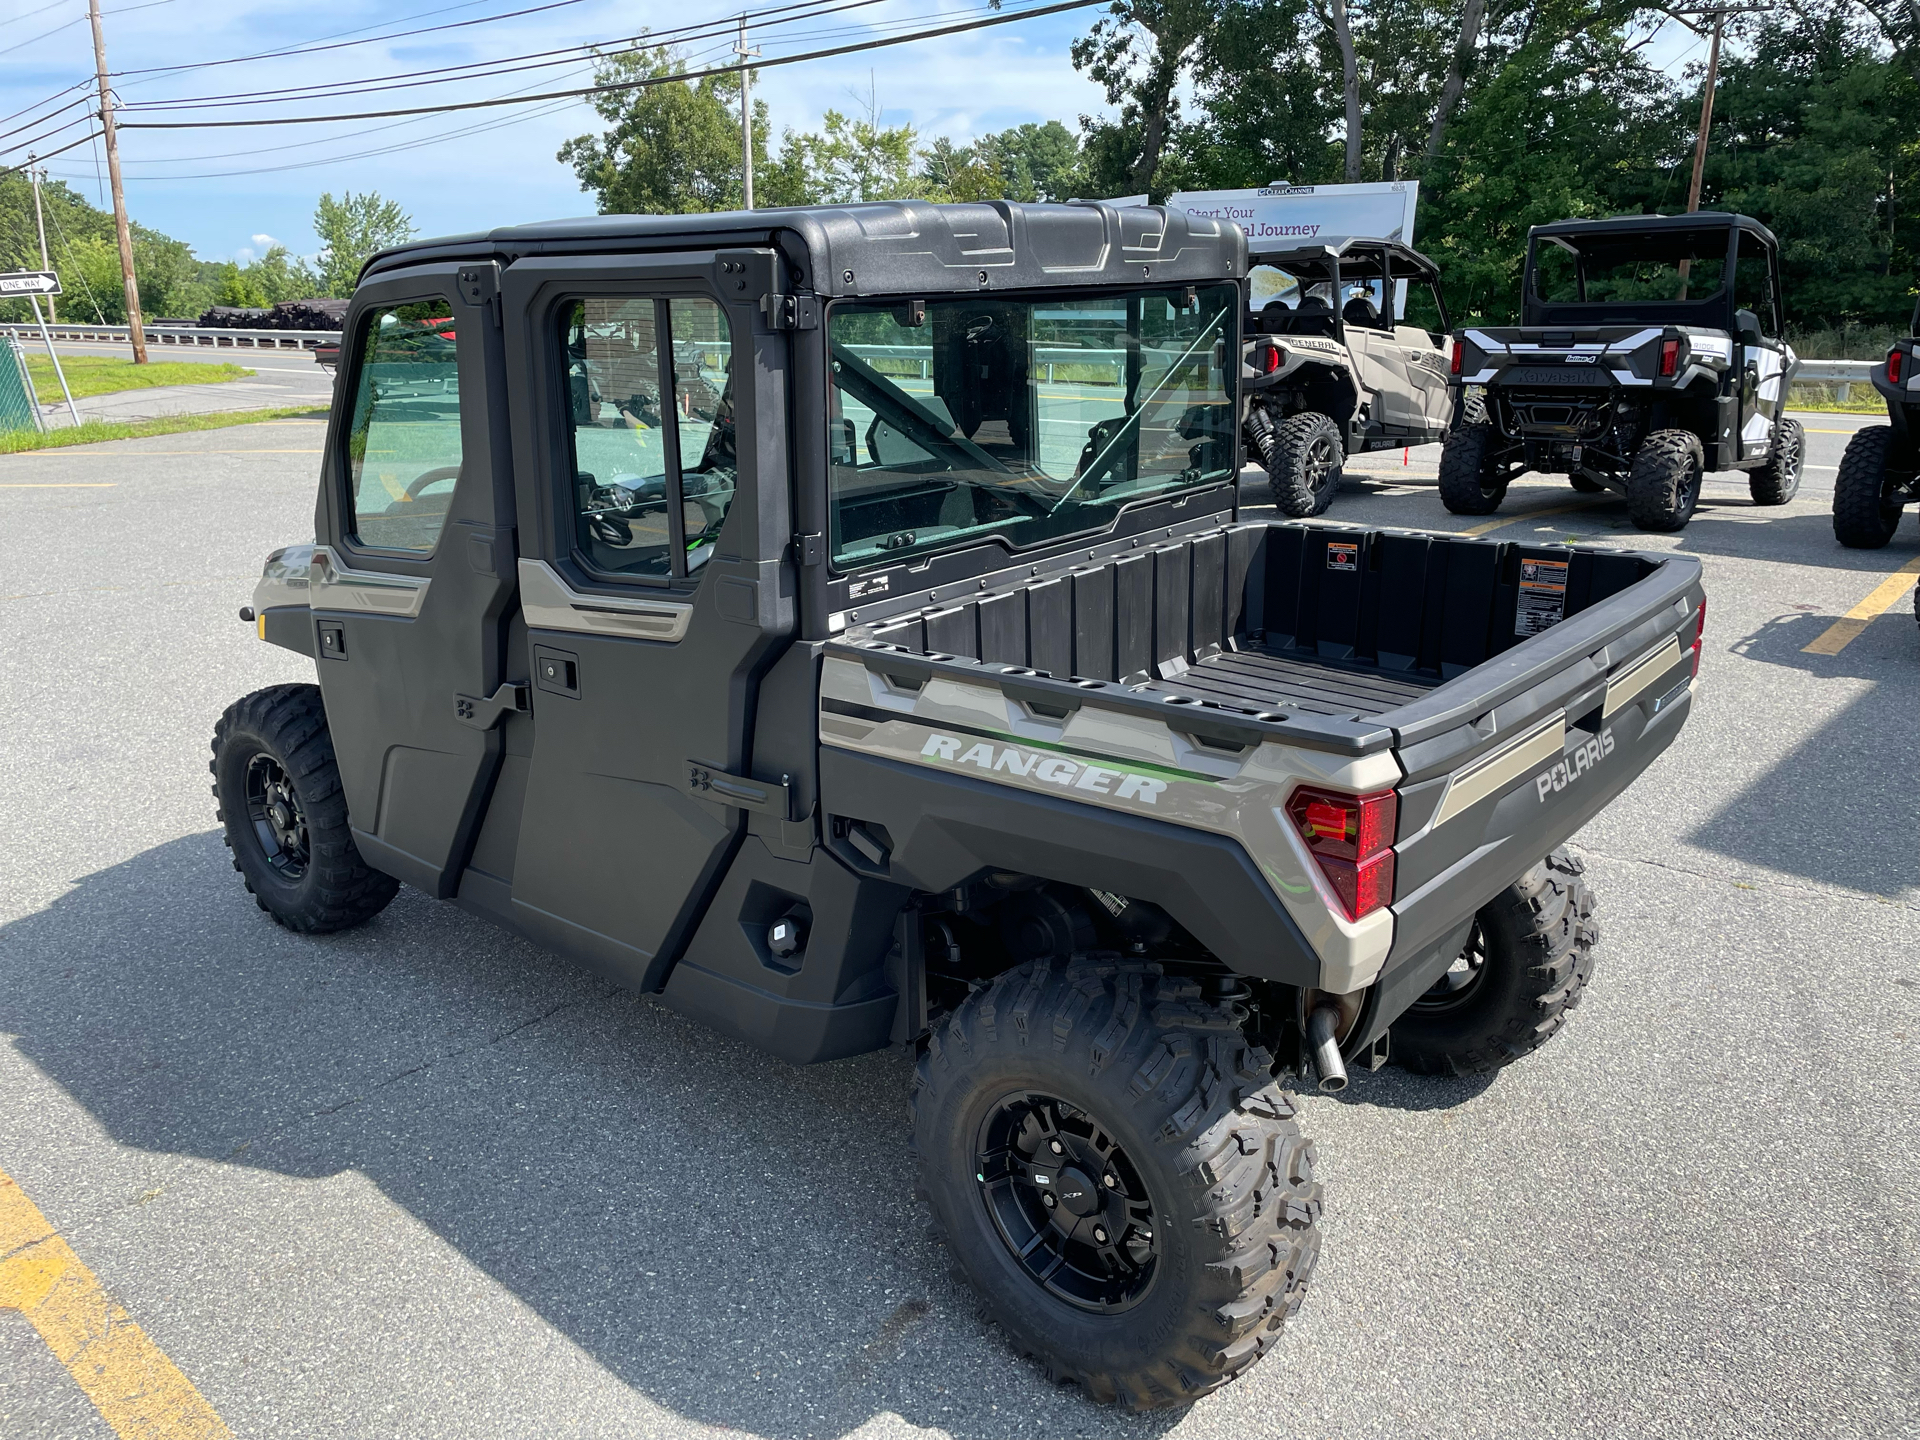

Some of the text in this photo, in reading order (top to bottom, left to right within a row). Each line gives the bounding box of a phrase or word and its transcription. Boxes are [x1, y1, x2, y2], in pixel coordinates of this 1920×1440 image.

[1224, 207, 1255, 219] Your
[1258, 223, 1320, 238] Journey
[3, 279, 40, 290] ONE WAY
[1291, 339, 1336, 350] GENERAL
[1693, 342, 1715, 350] RIDGE
[1371, 440, 1395, 449] POLARIS
[920, 733, 1168, 804] RANGER
[1536, 726, 1615, 803] POLARIS
